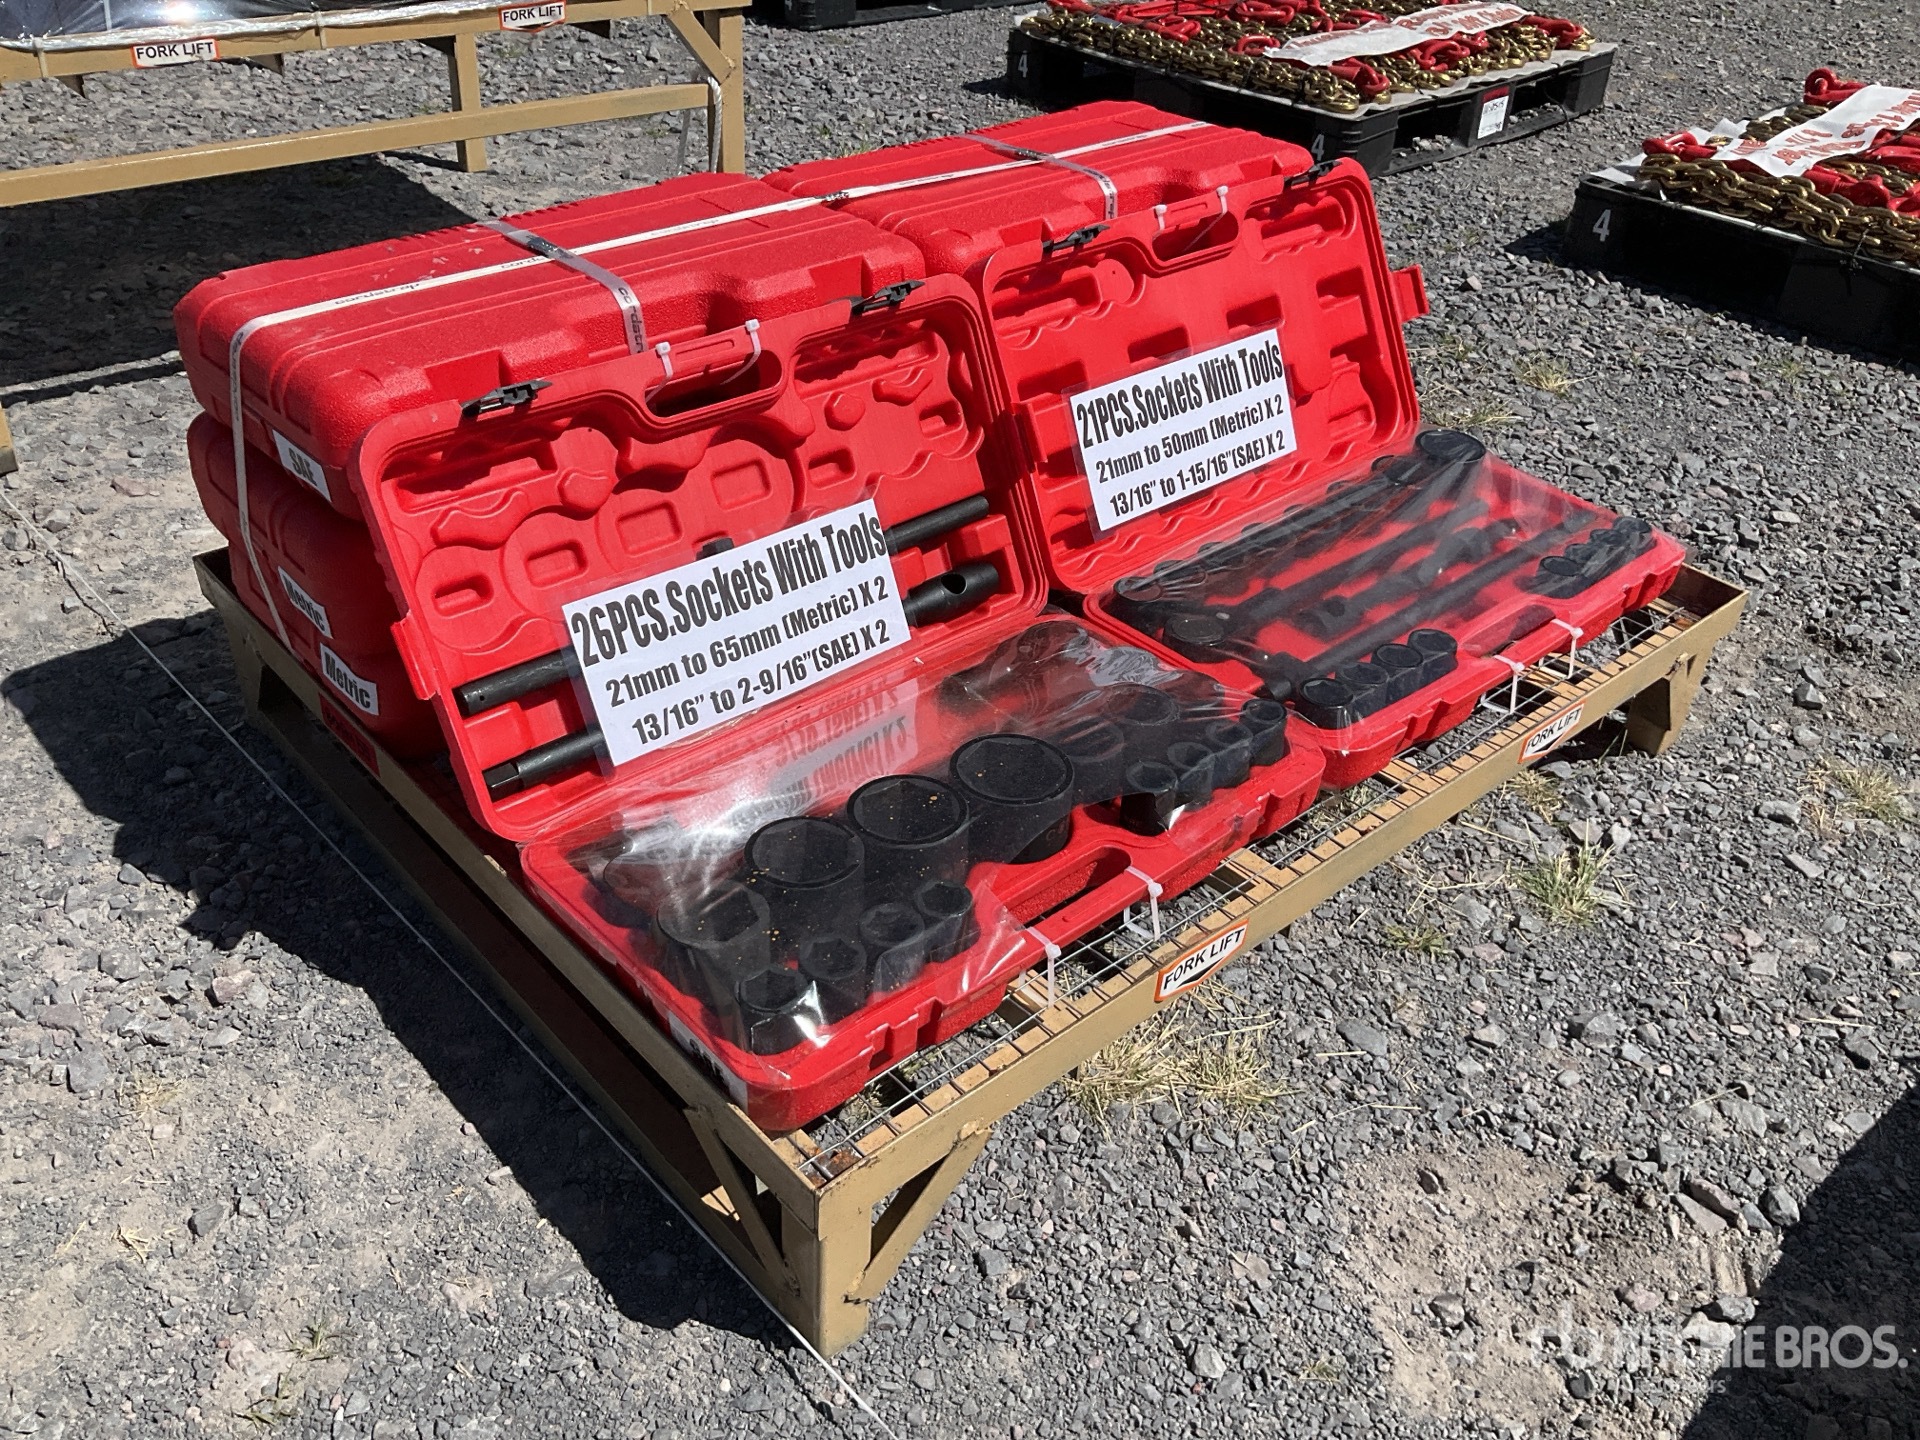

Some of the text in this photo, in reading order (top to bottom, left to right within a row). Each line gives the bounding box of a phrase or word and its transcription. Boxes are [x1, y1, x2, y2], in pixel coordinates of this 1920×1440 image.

[502, 5, 563, 23] FORK LIFT
[136, 42, 213, 60] FORK LIFT
[1017, 49, 1028, 78] 4
[1311, 133, 1325, 161] 4
[1592, 209, 1611, 242] 4
[334, 282, 420, 305] cordstrap
[1076, 340, 1283, 449] 21PCS.Sockets With Tools
[288, 446, 318, 487] SAE
[1095, 393, 1284, 483] 21mm to 50mm (Metric) X 2
[1159, 477, 1176, 498] to
[1266, 433, 1277, 455] X
[1276, 429, 1285, 451] 2
[284, 574, 326, 633] Metric
[571, 512, 887, 668] 26PCS.Sockets With Tools
[605, 575, 889, 708] 21mm to 65mm (Metric) X 2
[709, 688, 736, 714] to
[860, 624, 877, 651] X
[875, 618, 890, 645] 2
[324, 652, 372, 709] Metric
[1525, 707, 1582, 753] FORK LIFT
[1163, 928, 1245, 990] FORK LIFT
